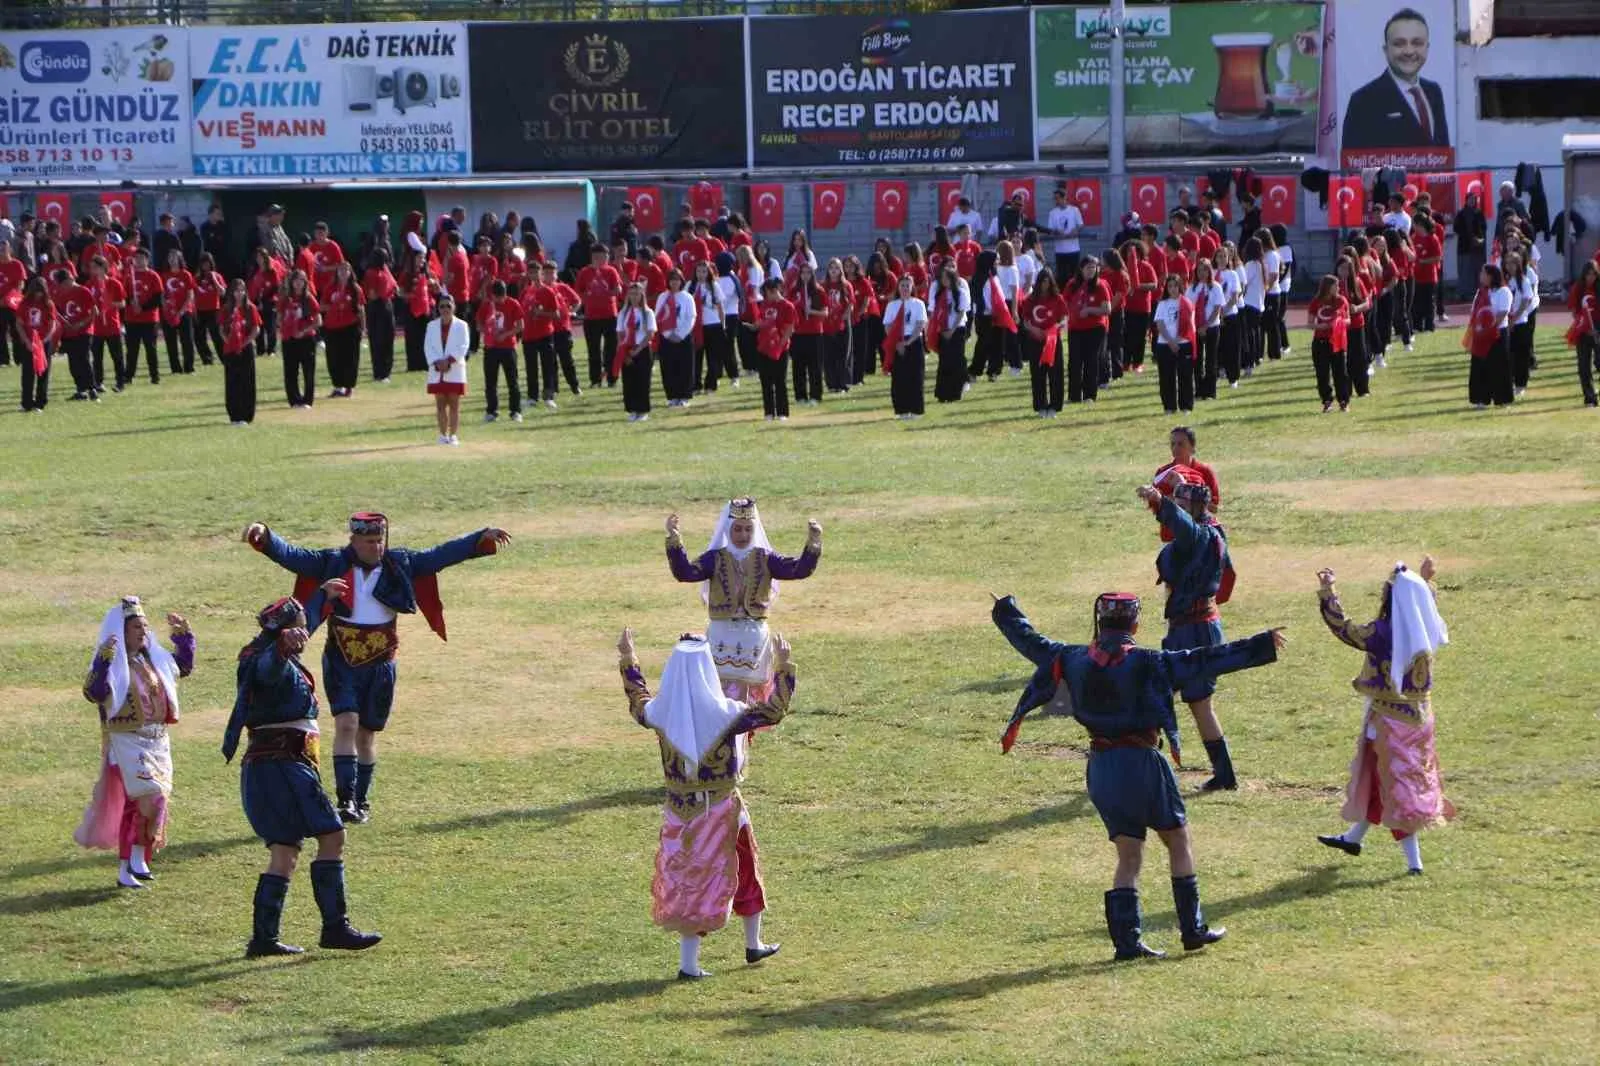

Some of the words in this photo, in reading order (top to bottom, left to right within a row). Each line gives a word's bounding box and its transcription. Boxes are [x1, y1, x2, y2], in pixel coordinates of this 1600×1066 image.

[327, 29, 370, 58] DAĞ
[375, 28, 457, 57] TEKNİK
[31, 54, 89, 70] Gündüz
[587, 48, 610, 74] E
[766, 63, 895, 93] ERDOĞAN
[902, 61, 1016, 91] TİCARET
[1054, 70, 1146, 87] SINIRIZ
[1151, 67, 1195, 88] ÇAY
[49, 88, 180, 123] GÜNDÜZ
[217, 80, 322, 108] DAIKIN
[550, 89, 648, 117] ÇİVRİL
[782, 103, 866, 128] RECEP
[874, 96, 1000, 126] ERDOĞAN
[0, 126, 87, 145] Ürünleri
[92, 128, 176, 145] Ticareti
[523, 116, 593, 141] ELİT
[601, 117, 679, 140] OTEL
[36, 149, 72, 162] 713
[79, 149, 103, 161] 10
[110, 148, 133, 161] 13
[360, 138, 368, 153] 0
[371, 138, 394, 153] 543
[397, 137, 420, 152] 503
[423, 137, 438, 152] 50
[838, 149, 865, 161] TEL:
[868, 150, 877, 160] 0
[296, 155, 373, 174] TEKNİK
[381, 153, 461, 173] SERVİS
